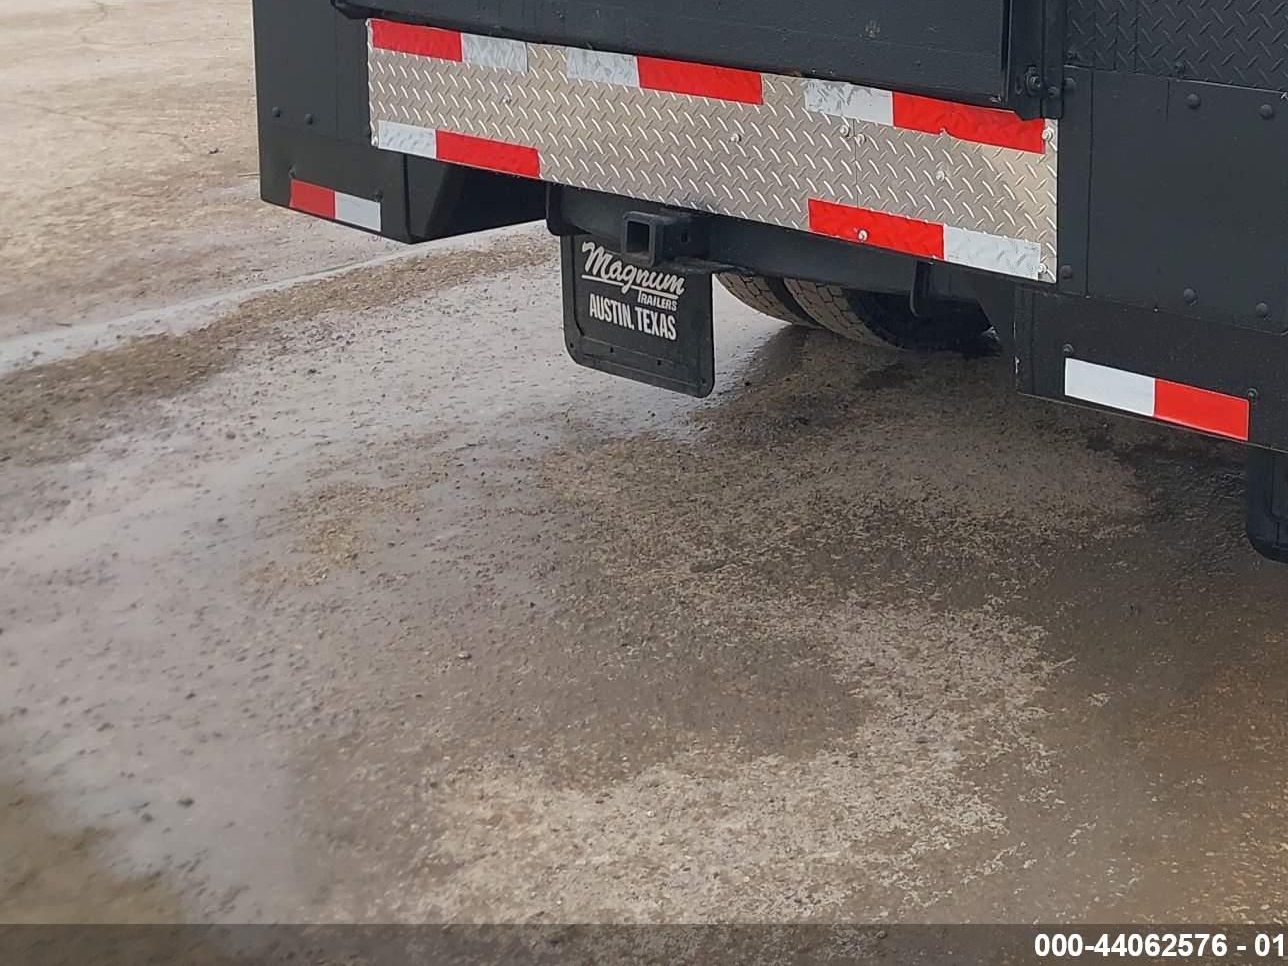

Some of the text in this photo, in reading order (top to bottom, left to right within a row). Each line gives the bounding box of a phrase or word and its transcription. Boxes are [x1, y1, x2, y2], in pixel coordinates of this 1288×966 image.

[581, 241, 685, 295] Magnum
[637, 290, 678, 312] TRAILERS
[634, 306, 677, 341] TEXAS
